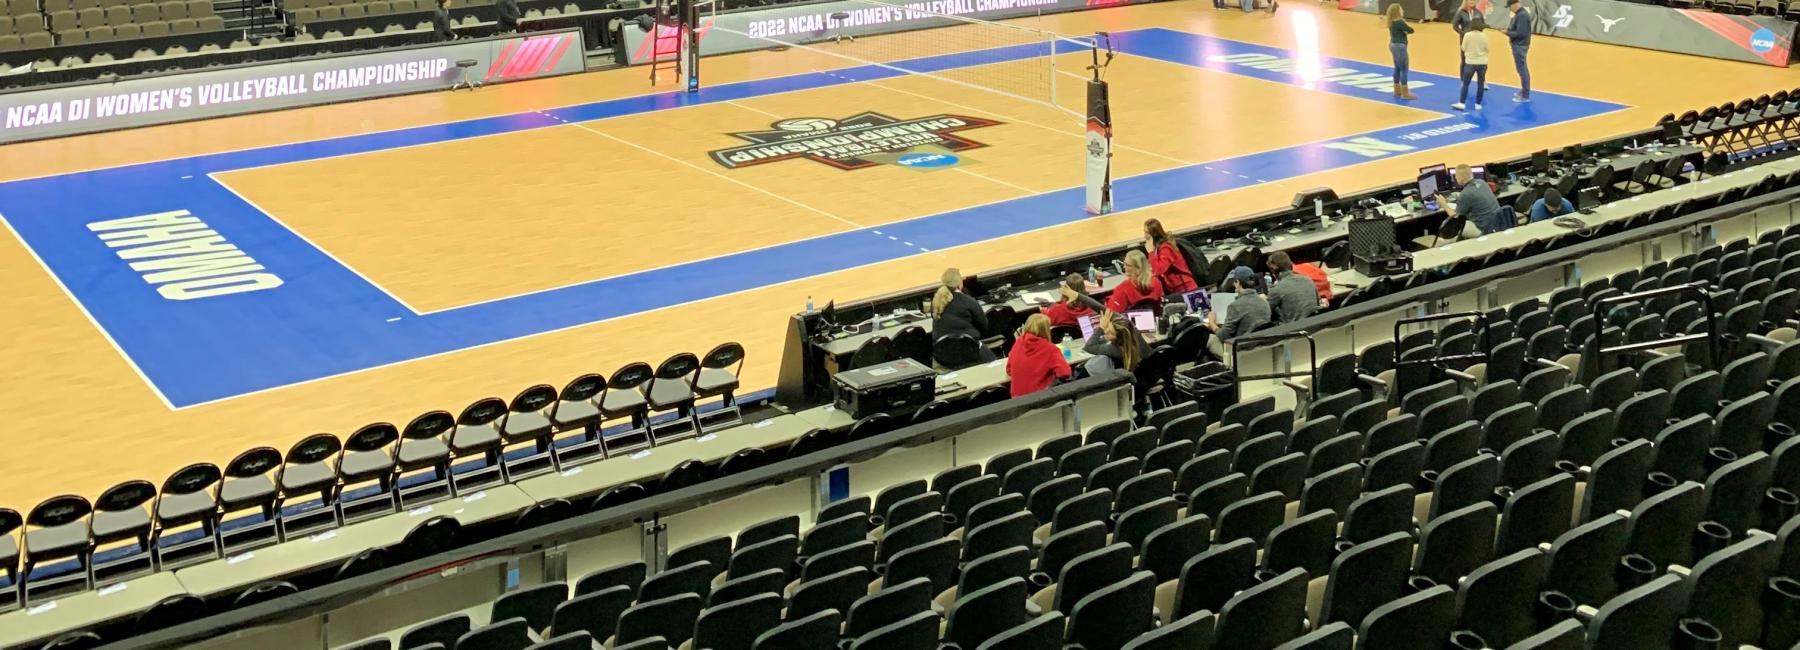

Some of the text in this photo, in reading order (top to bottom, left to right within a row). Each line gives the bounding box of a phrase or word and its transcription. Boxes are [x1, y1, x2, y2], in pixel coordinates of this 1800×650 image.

[749, 18, 786, 39] 2022
[788, 13, 825, 34] NCAA
[904, 0, 975, 20] VOLLEYBALL
[1753, 39, 1775, 49] NCAA
[6, 58, 448, 129] NCAA DI WOMEN'S VOLLEYBALL CHAMPIONSHIP
[729, 117, 967, 163] CHAMPIONSHIP
[806, 131, 939, 158] VOLLEYBALL
[86, 209, 285, 300] OMAHA
